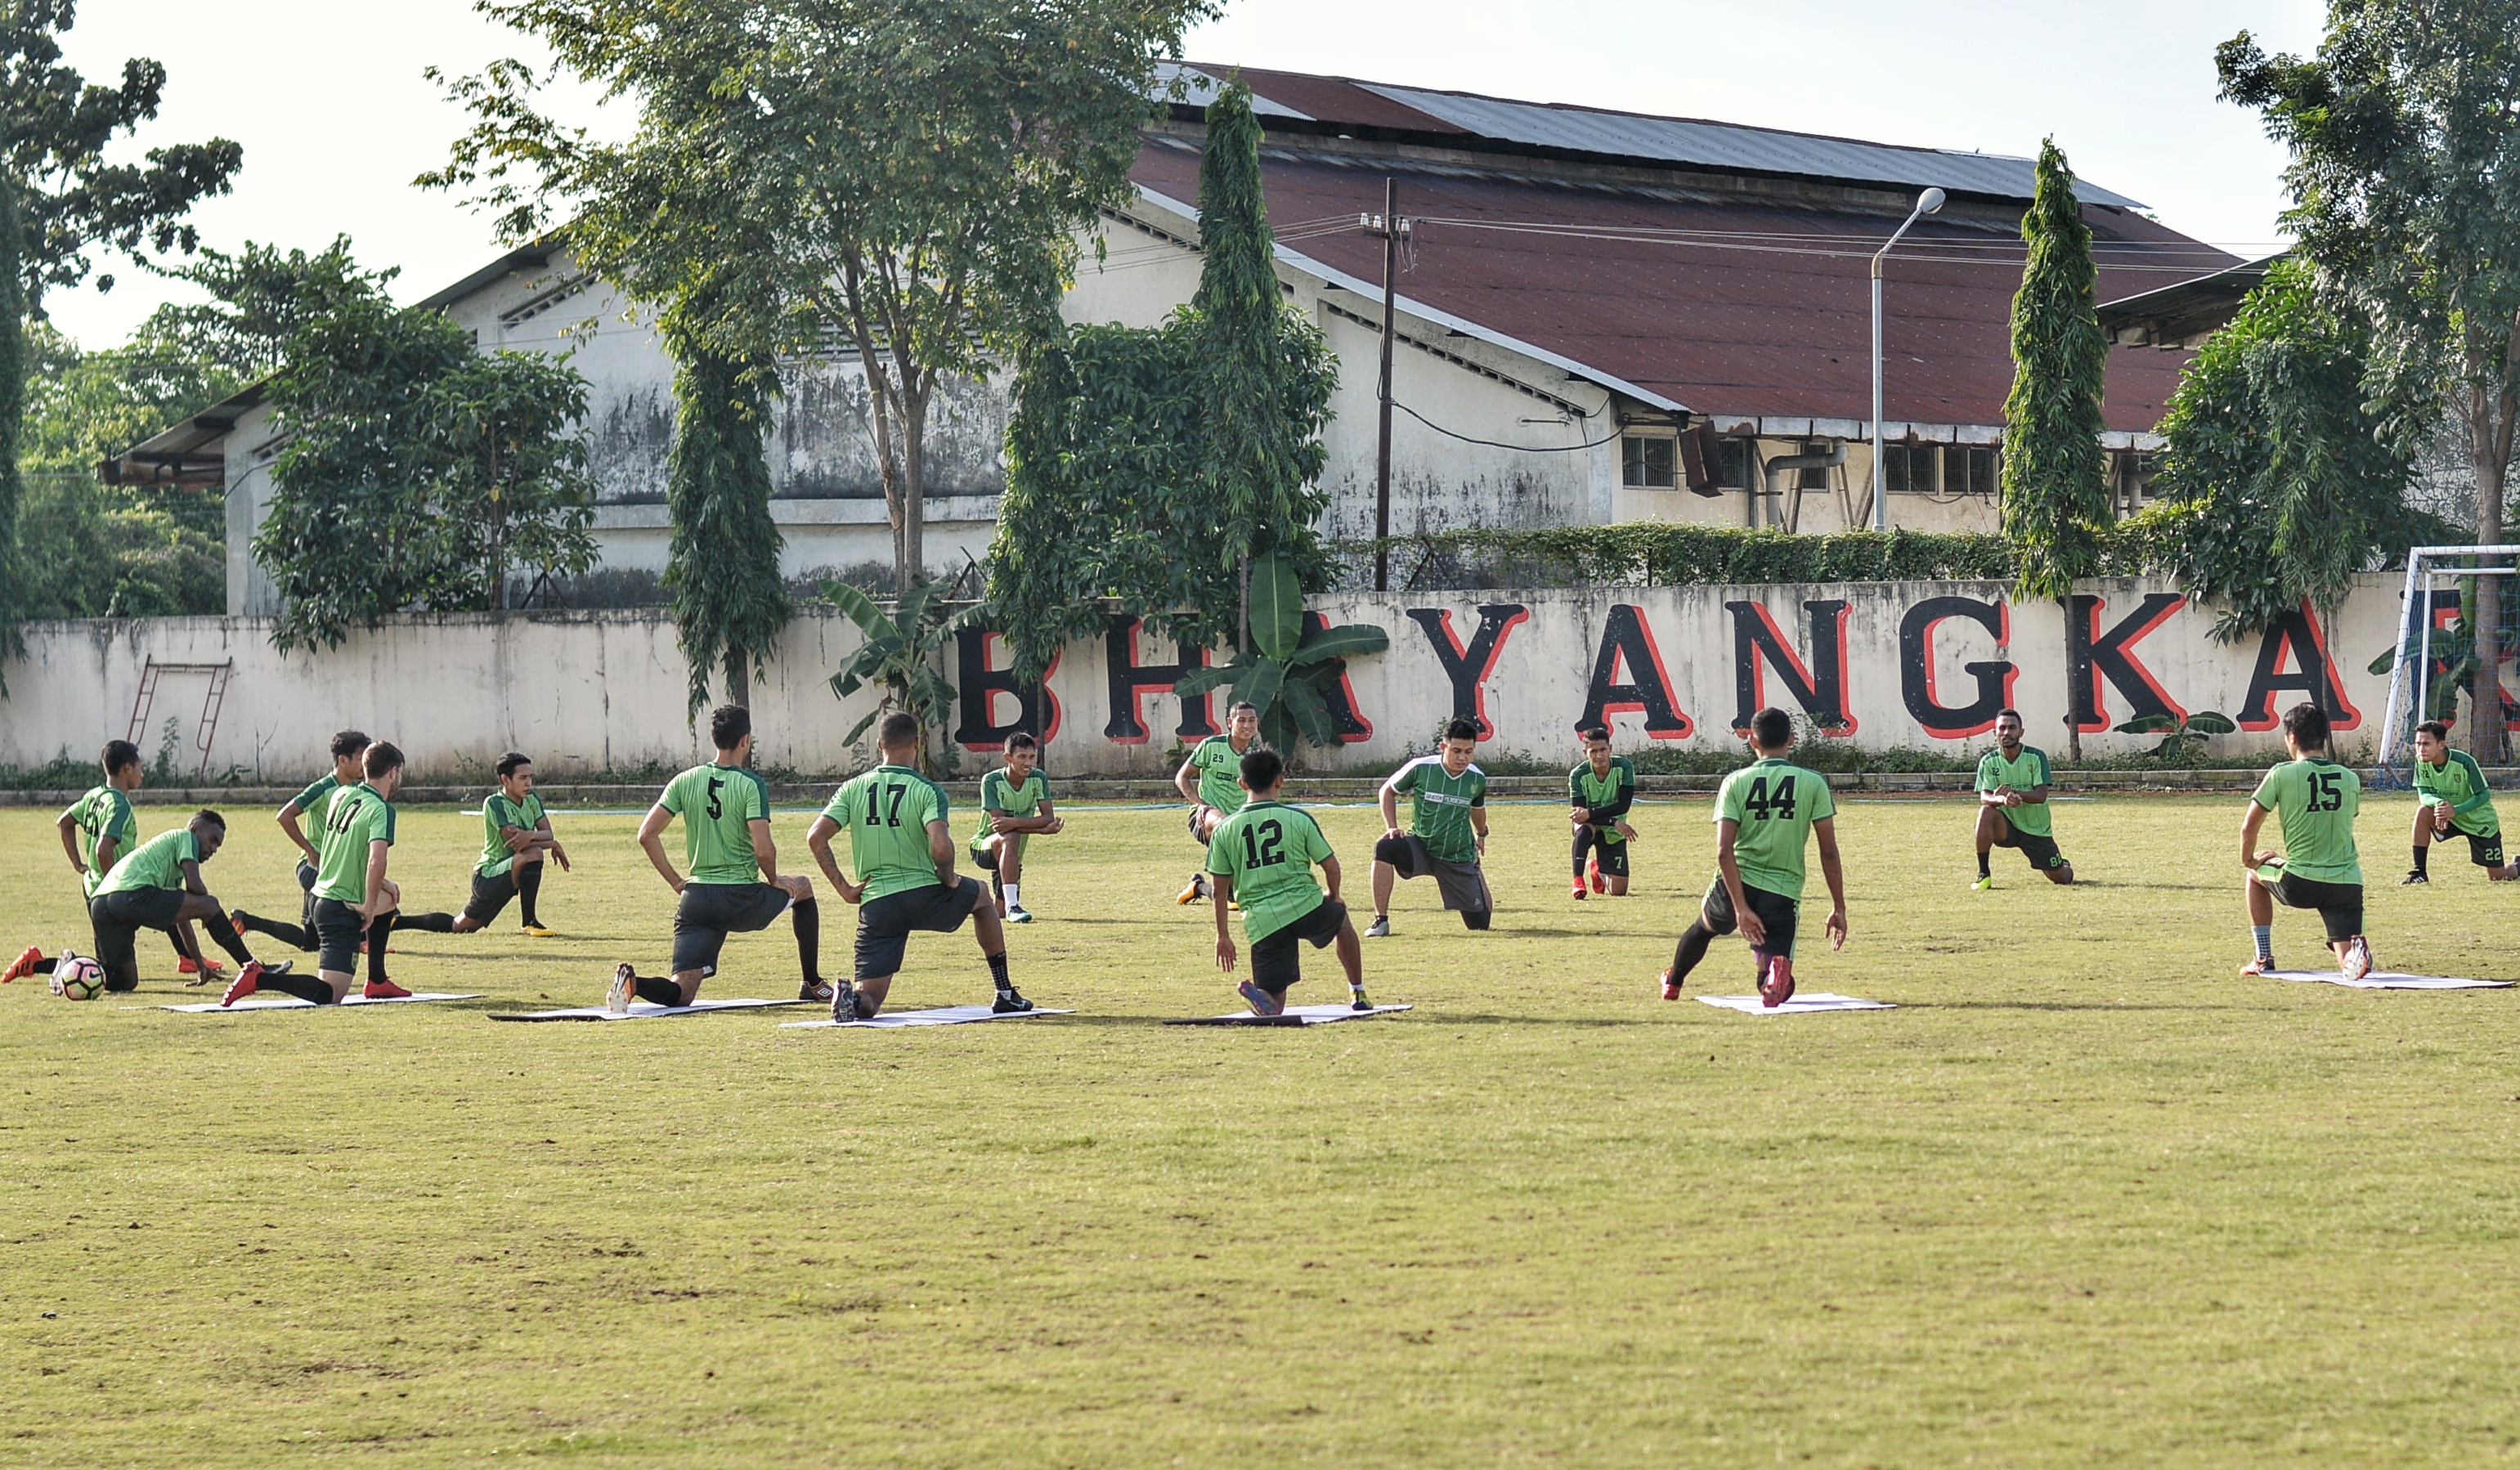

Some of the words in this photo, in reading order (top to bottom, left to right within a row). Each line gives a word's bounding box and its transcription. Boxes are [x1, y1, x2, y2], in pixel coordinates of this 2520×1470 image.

[1213, 754, 1224, 764] 29
[706, 776, 725, 821] 5
[866, 782, 907, 827] 17
[1746, 775, 1796, 820] 44
[2307, 771, 2343, 813] 15
[327, 793, 362, 835] 10
[1241, 818, 1285, 870] 12
[1614, 856, 1622, 869] 7
[2485, 847, 2501, 861] 22
